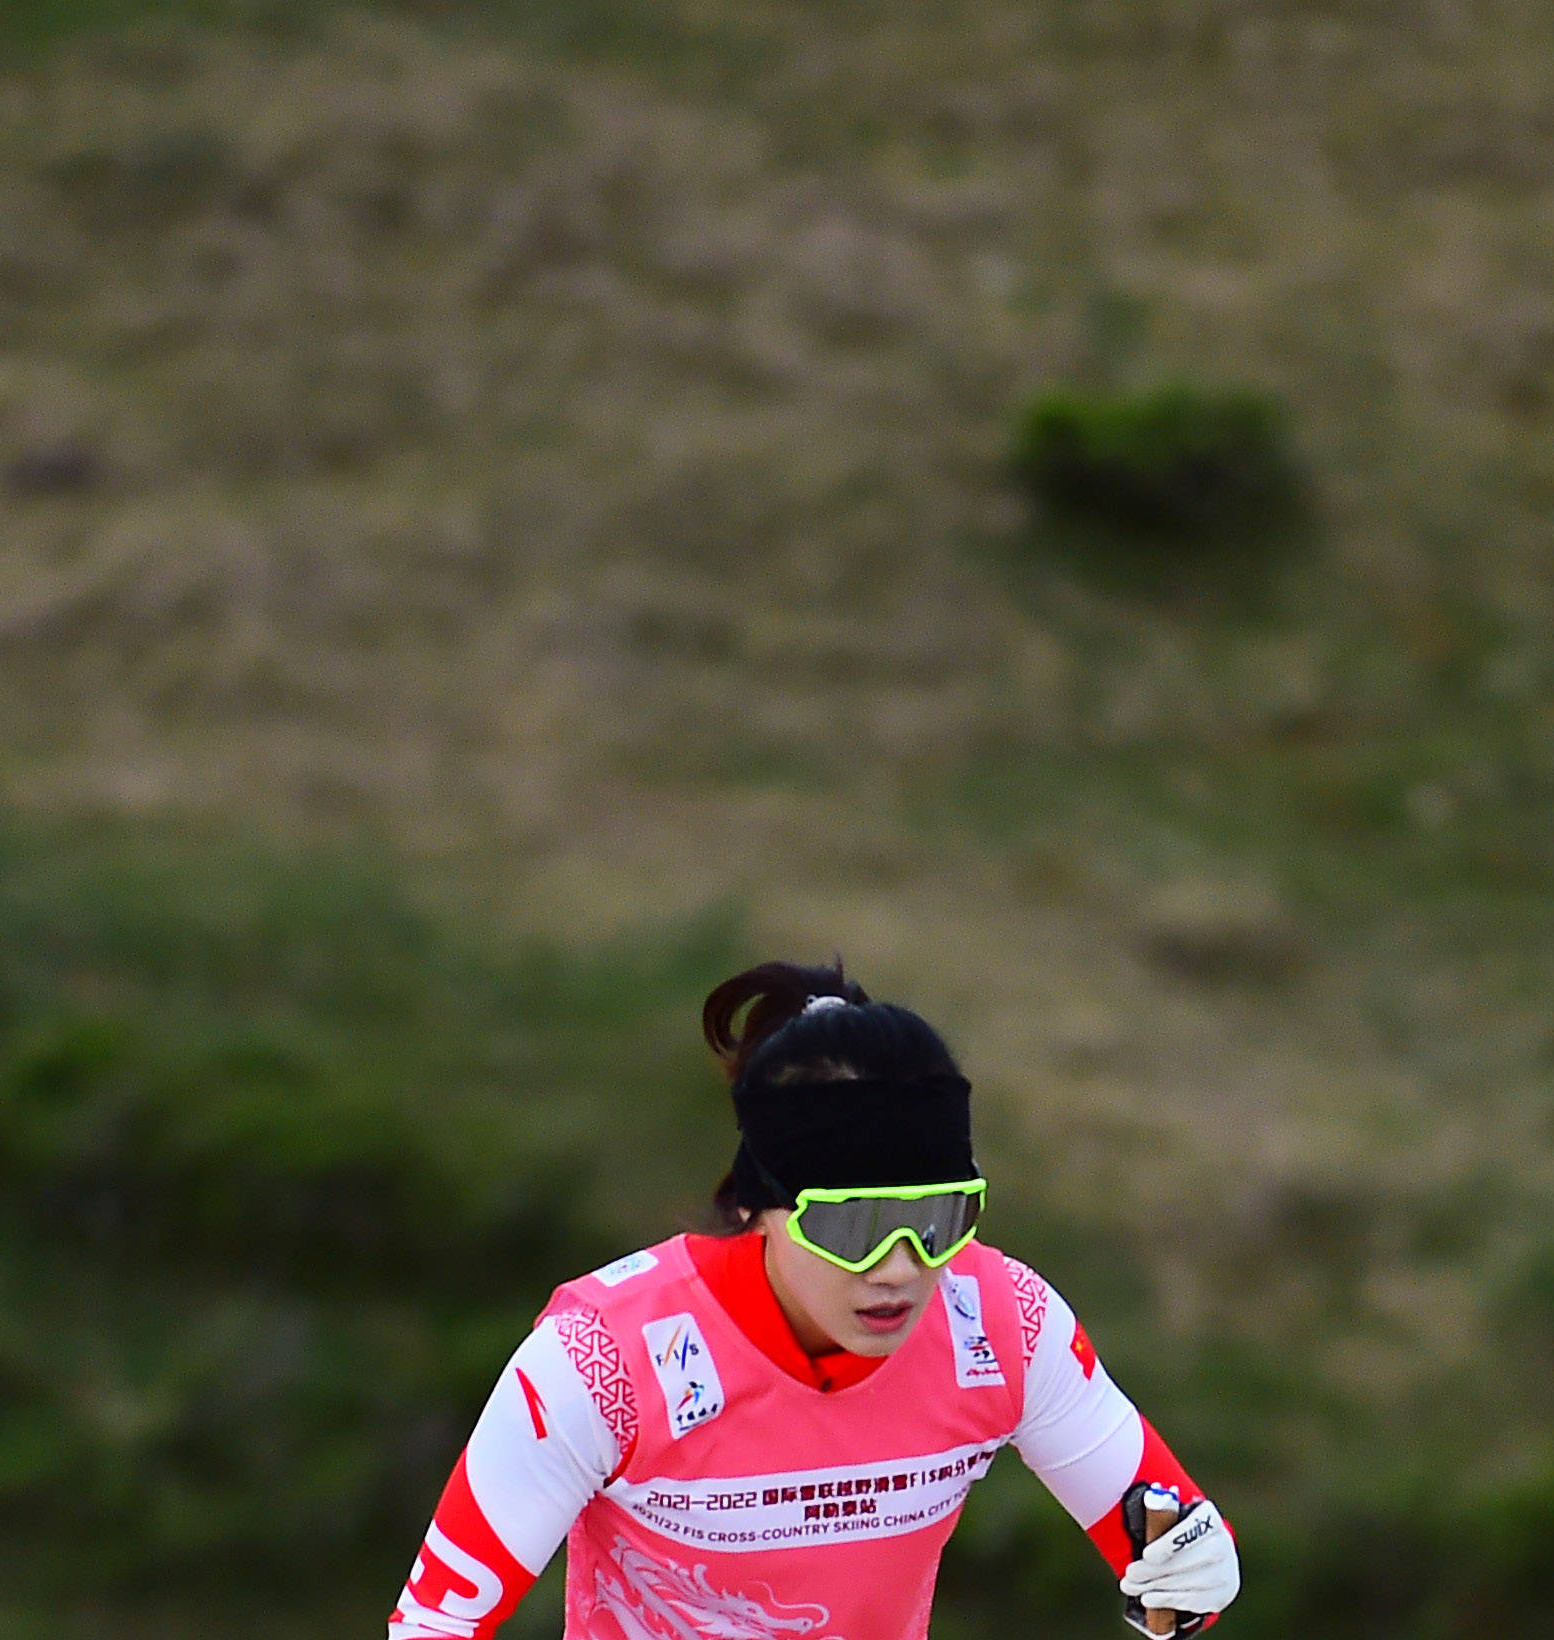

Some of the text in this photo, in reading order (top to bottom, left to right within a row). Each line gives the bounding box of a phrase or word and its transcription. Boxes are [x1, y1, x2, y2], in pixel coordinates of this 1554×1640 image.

[656, 1334, 699, 1368] FIS
[683, 1525, 704, 1540] FIS
[707, 1522, 830, 1543] CROSS-COUNTRY
[833, 1517, 880, 1533] SKIING
[883, 1510, 925, 1527] CHINA
[928, 1500, 950, 1517] CITY
